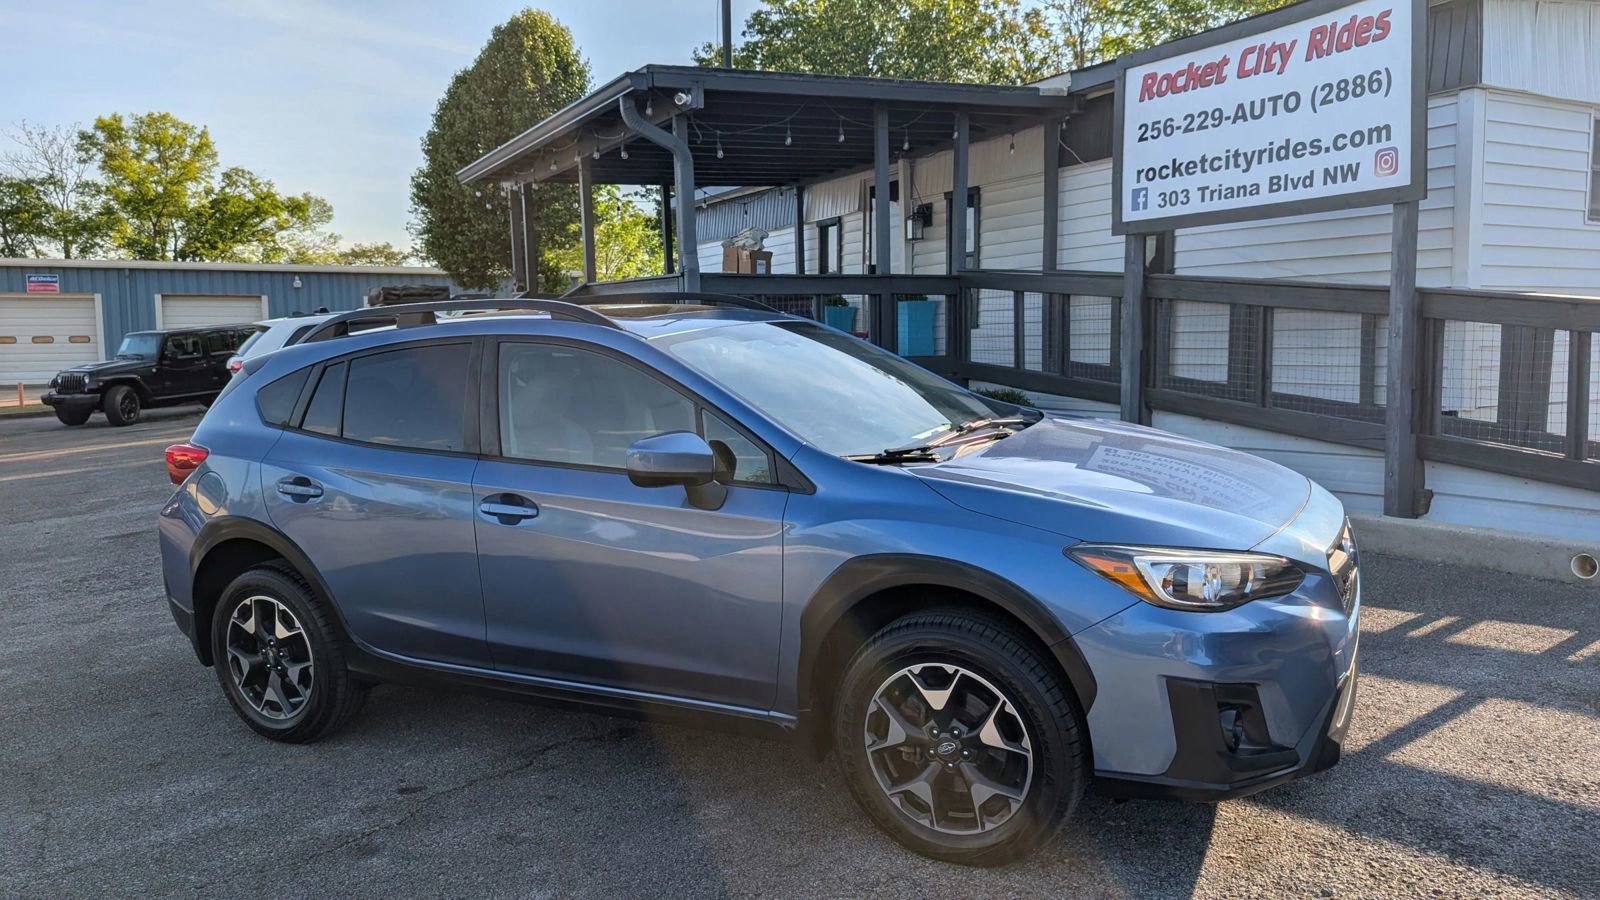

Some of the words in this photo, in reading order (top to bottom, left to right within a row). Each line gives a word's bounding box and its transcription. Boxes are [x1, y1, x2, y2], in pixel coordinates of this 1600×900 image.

[1139, 55, 1230, 103] Rocket
[1237, 40, 1297, 79] City
[1305, 9, 1392, 62] Rides
[1137, 91, 1301, 143] 256-229-AUTO
[1311, 67, 1392, 113] (2886)
[1136, 124, 1392, 184] rocketcityrides.com
[1157, 189, 1190, 209] 303
[1197, 183, 1260, 203] Triana
[1268, 170, 1314, 194] Blvd
[1323, 162, 1360, 186] NW
